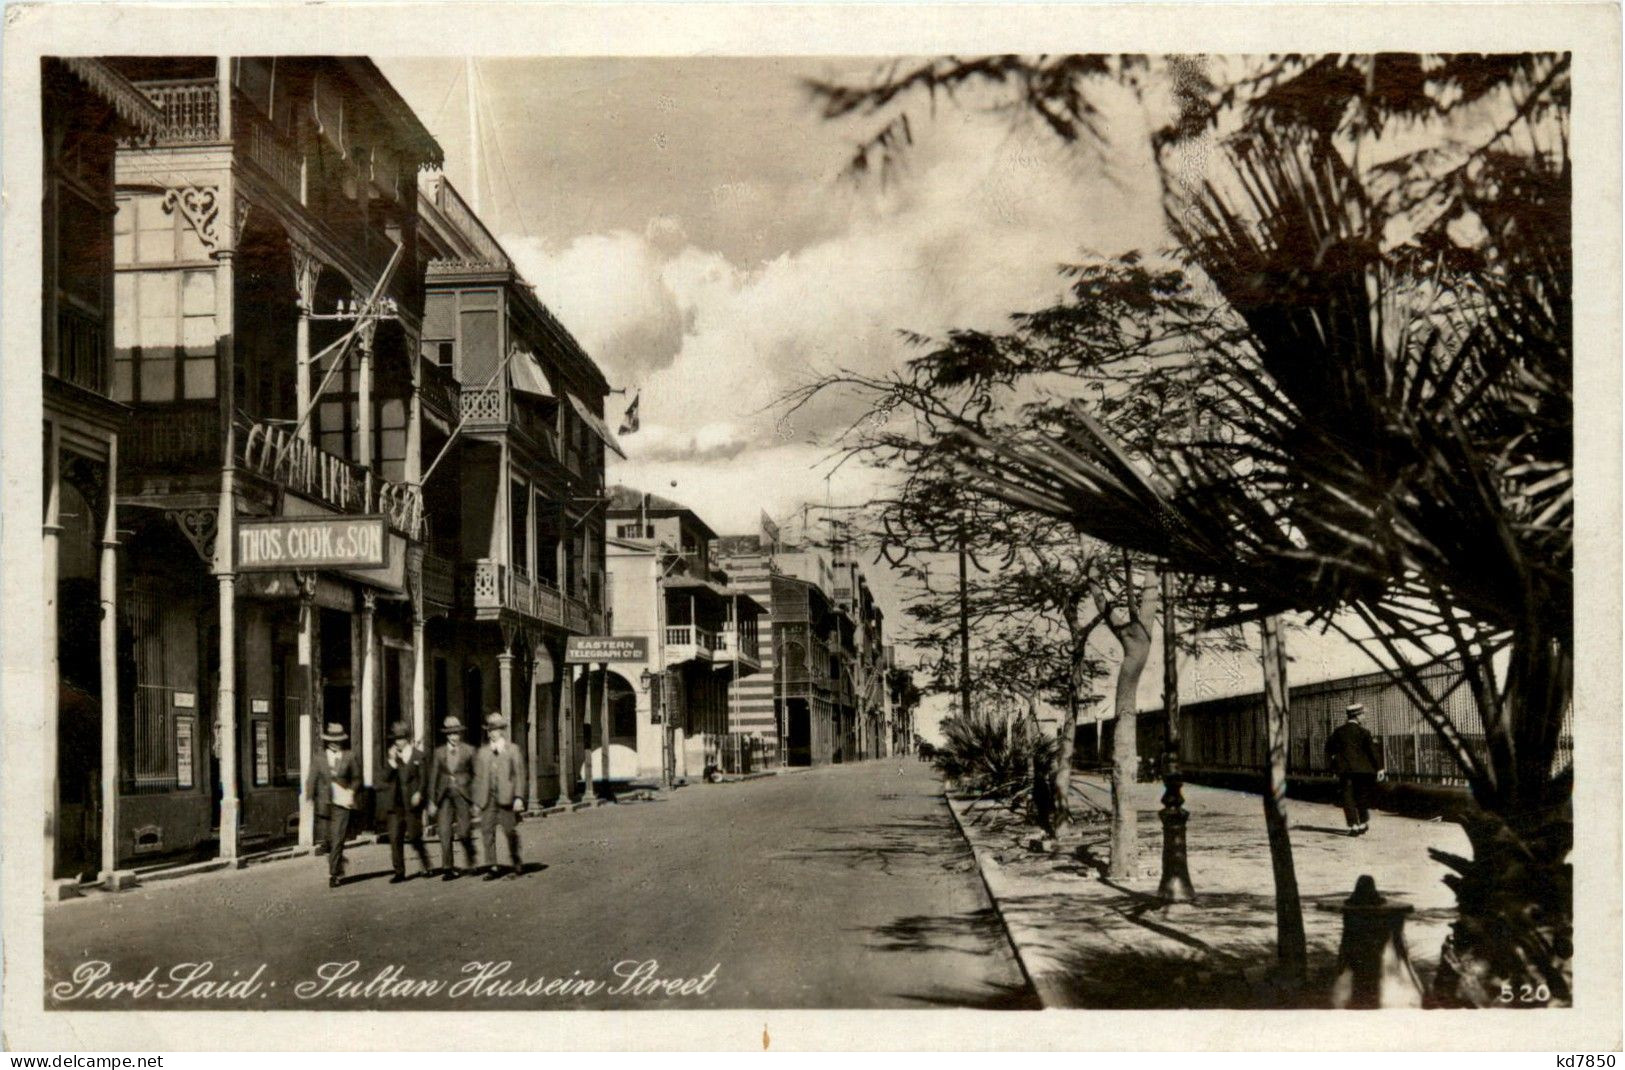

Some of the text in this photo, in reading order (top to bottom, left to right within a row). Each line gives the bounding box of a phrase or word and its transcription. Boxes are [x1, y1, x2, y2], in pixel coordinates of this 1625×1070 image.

[239, 525, 383, 564] THOS. COOK & SON
[577, 641, 634, 649] EASTERN
[570, 649, 621, 658] TELEGRAPH
